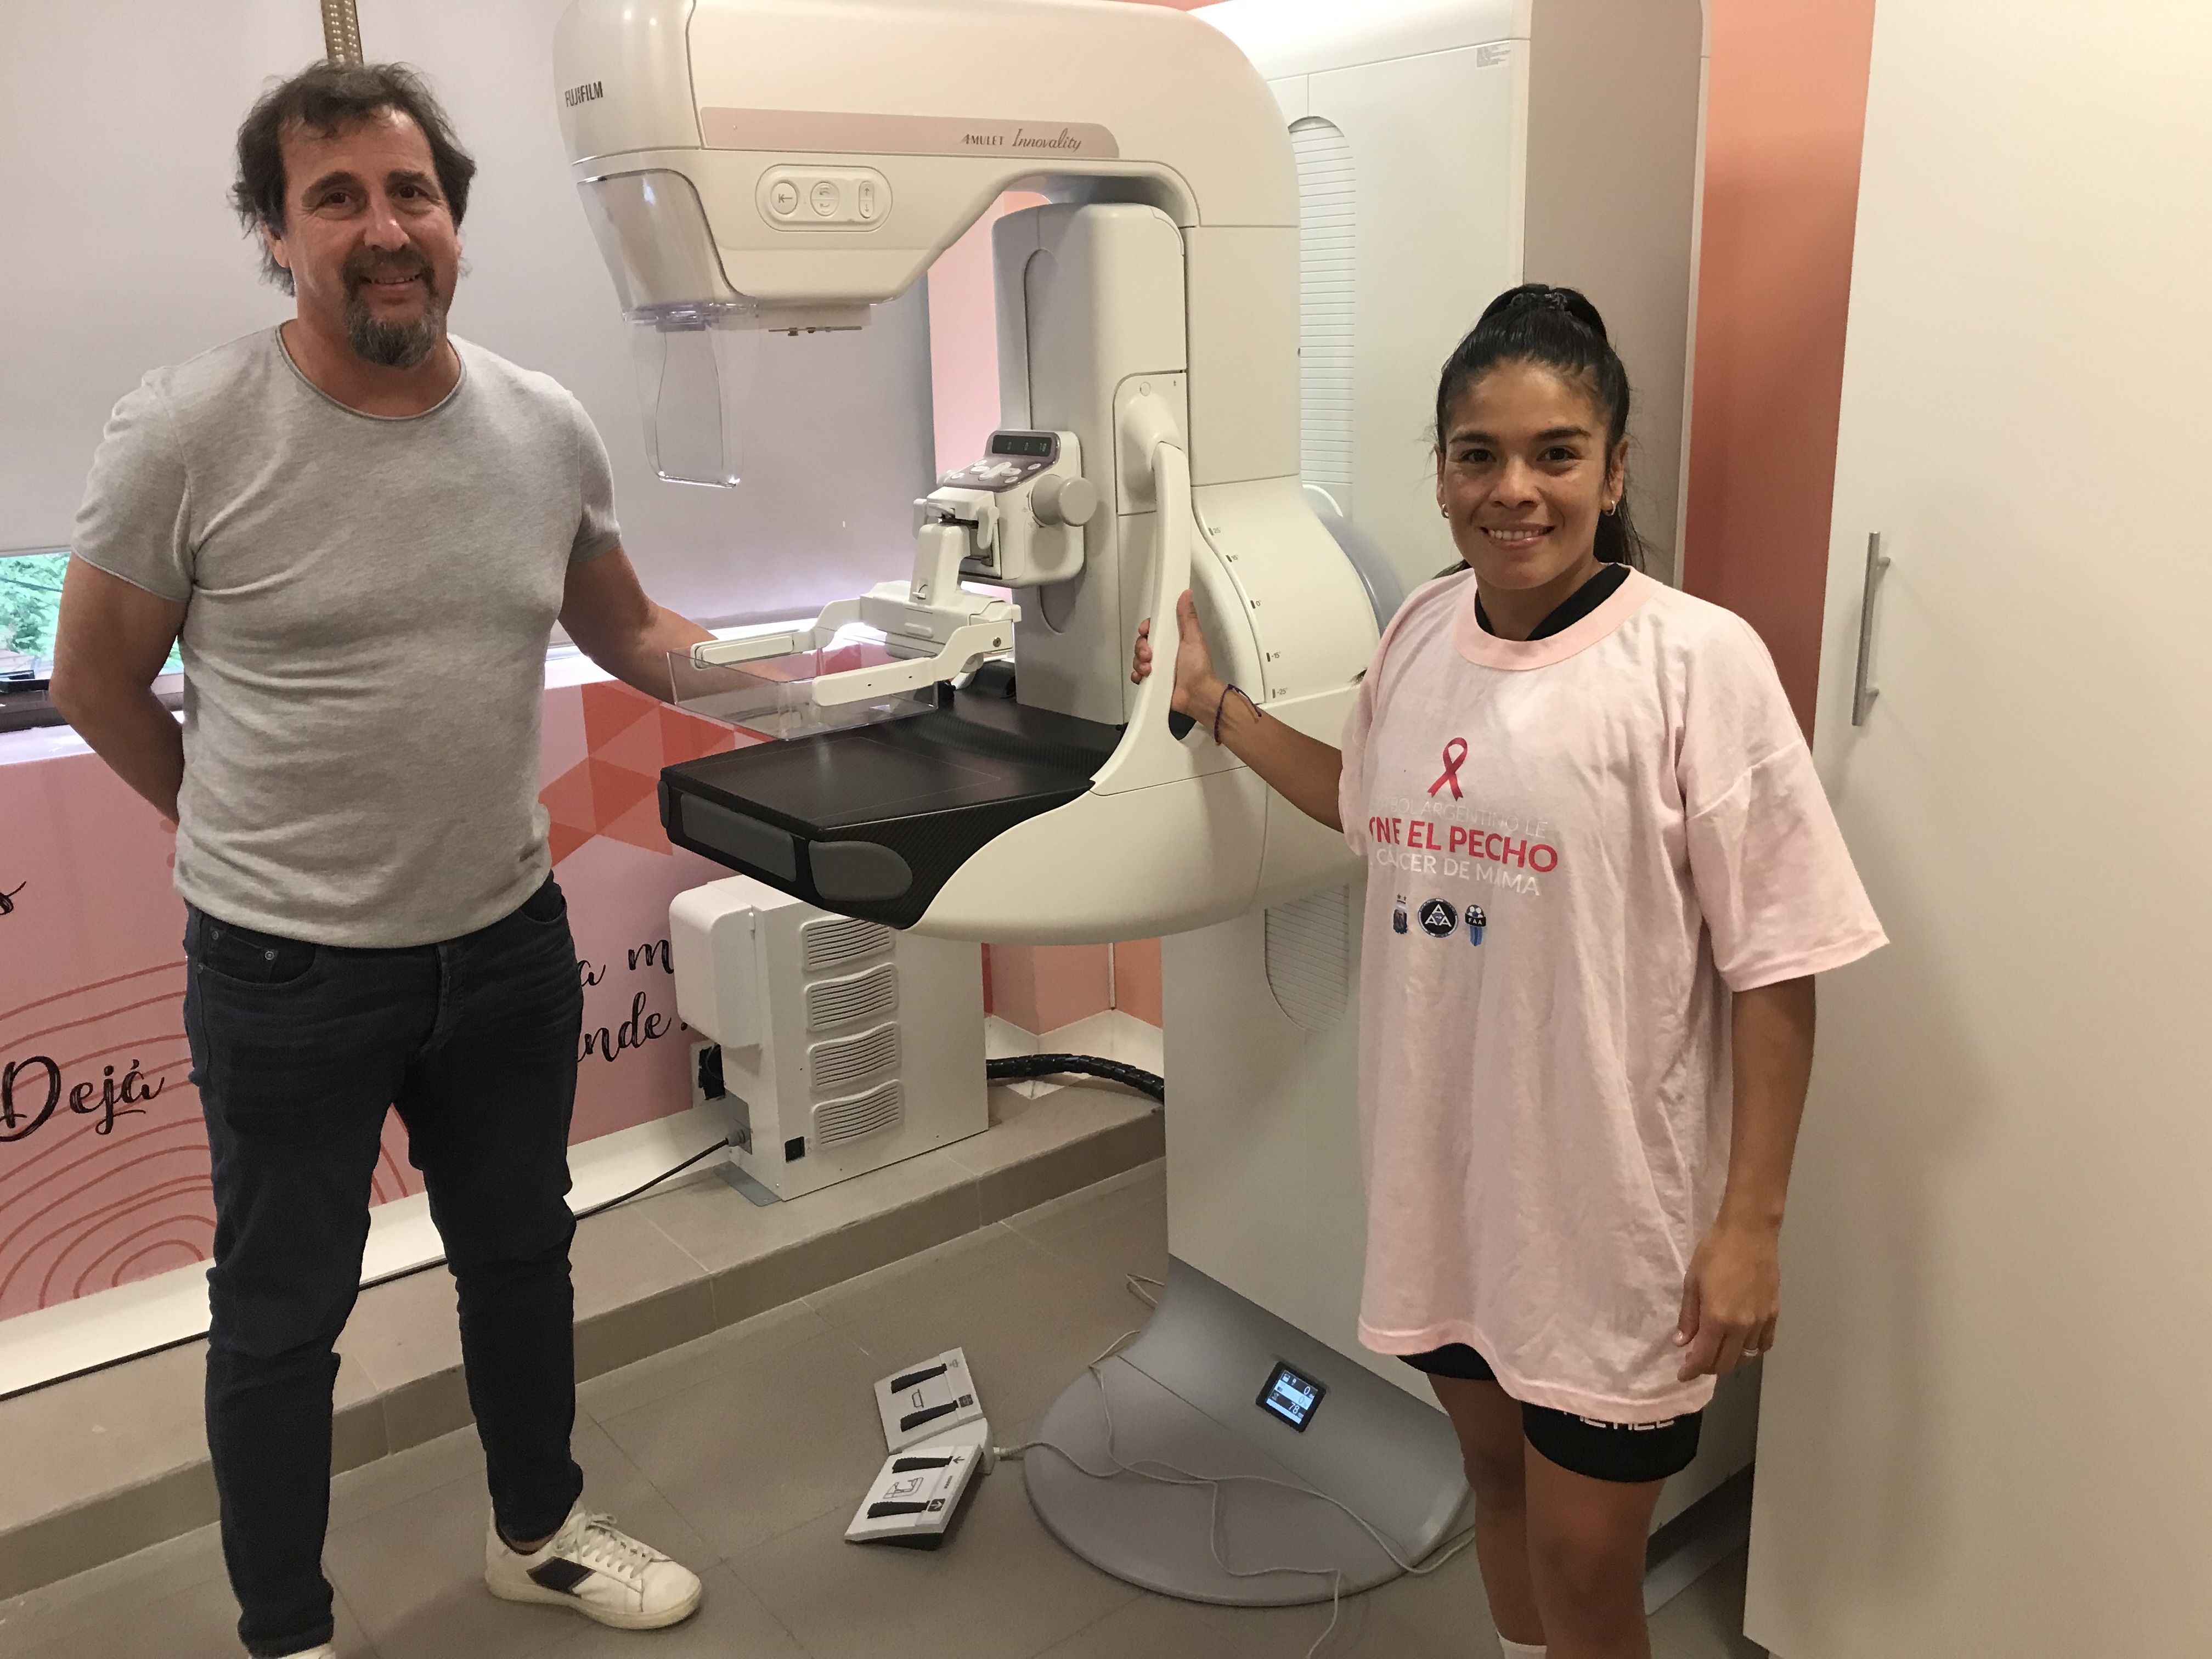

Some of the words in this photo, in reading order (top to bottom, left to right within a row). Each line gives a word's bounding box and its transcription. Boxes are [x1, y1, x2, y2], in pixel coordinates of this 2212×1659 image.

[564, 81, 603, 108] FUJIFILM
[960, 133, 1005, 145] AMULET
[1011, 127, 1082, 153] Innovality
[1525, 819, 1548, 839] LE
[1407, 820, 1442, 851] EL
[1448, 825, 1558, 872] PECHO
[1443, 857, 1470, 881] DE
[0, 1055, 165, 1142] Dejá
[1289, 1402, 1300, 1414] 78
